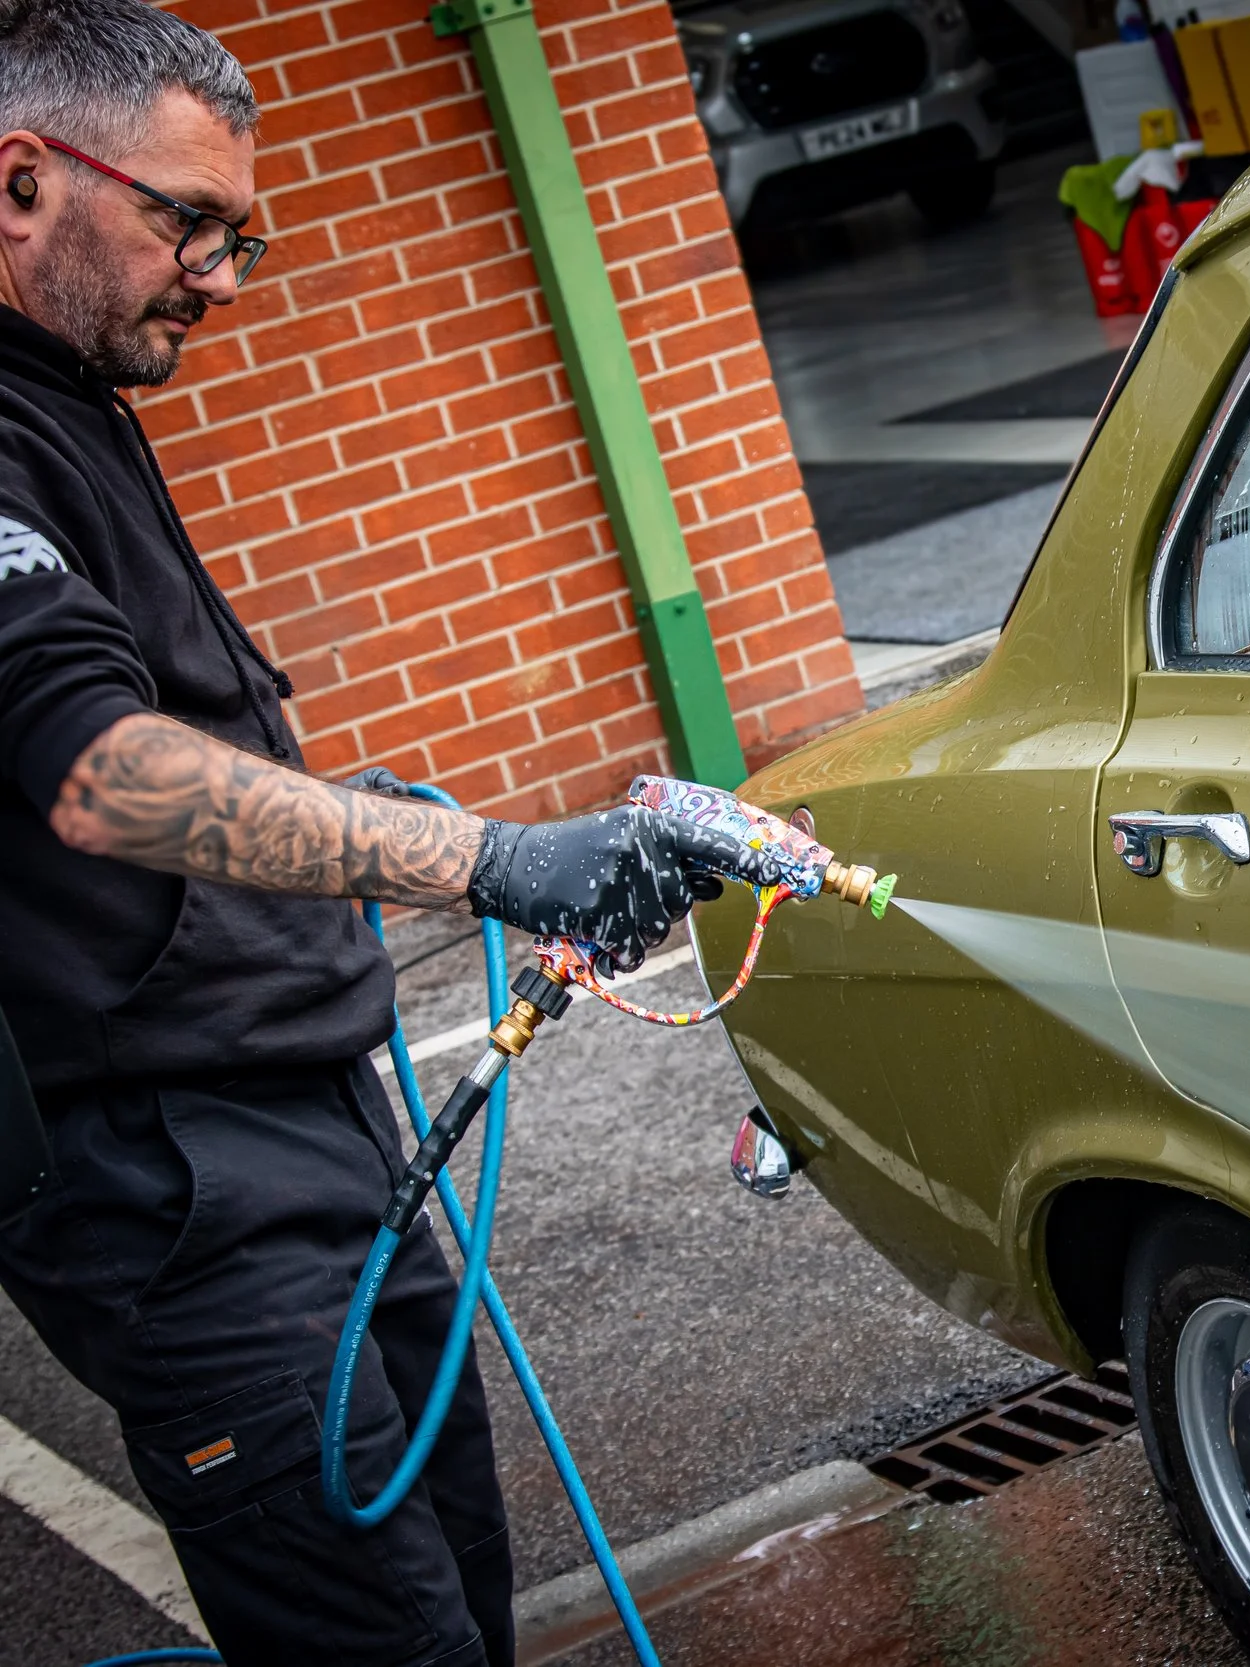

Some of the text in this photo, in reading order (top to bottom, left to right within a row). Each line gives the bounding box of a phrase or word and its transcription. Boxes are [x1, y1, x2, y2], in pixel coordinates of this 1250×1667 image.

[337, 1375, 351, 1406] Washer
[344, 1351, 357, 1373] Hose
[351, 1333, 361, 1349] 400
[363, 1281, 378, 1307] 100°C
